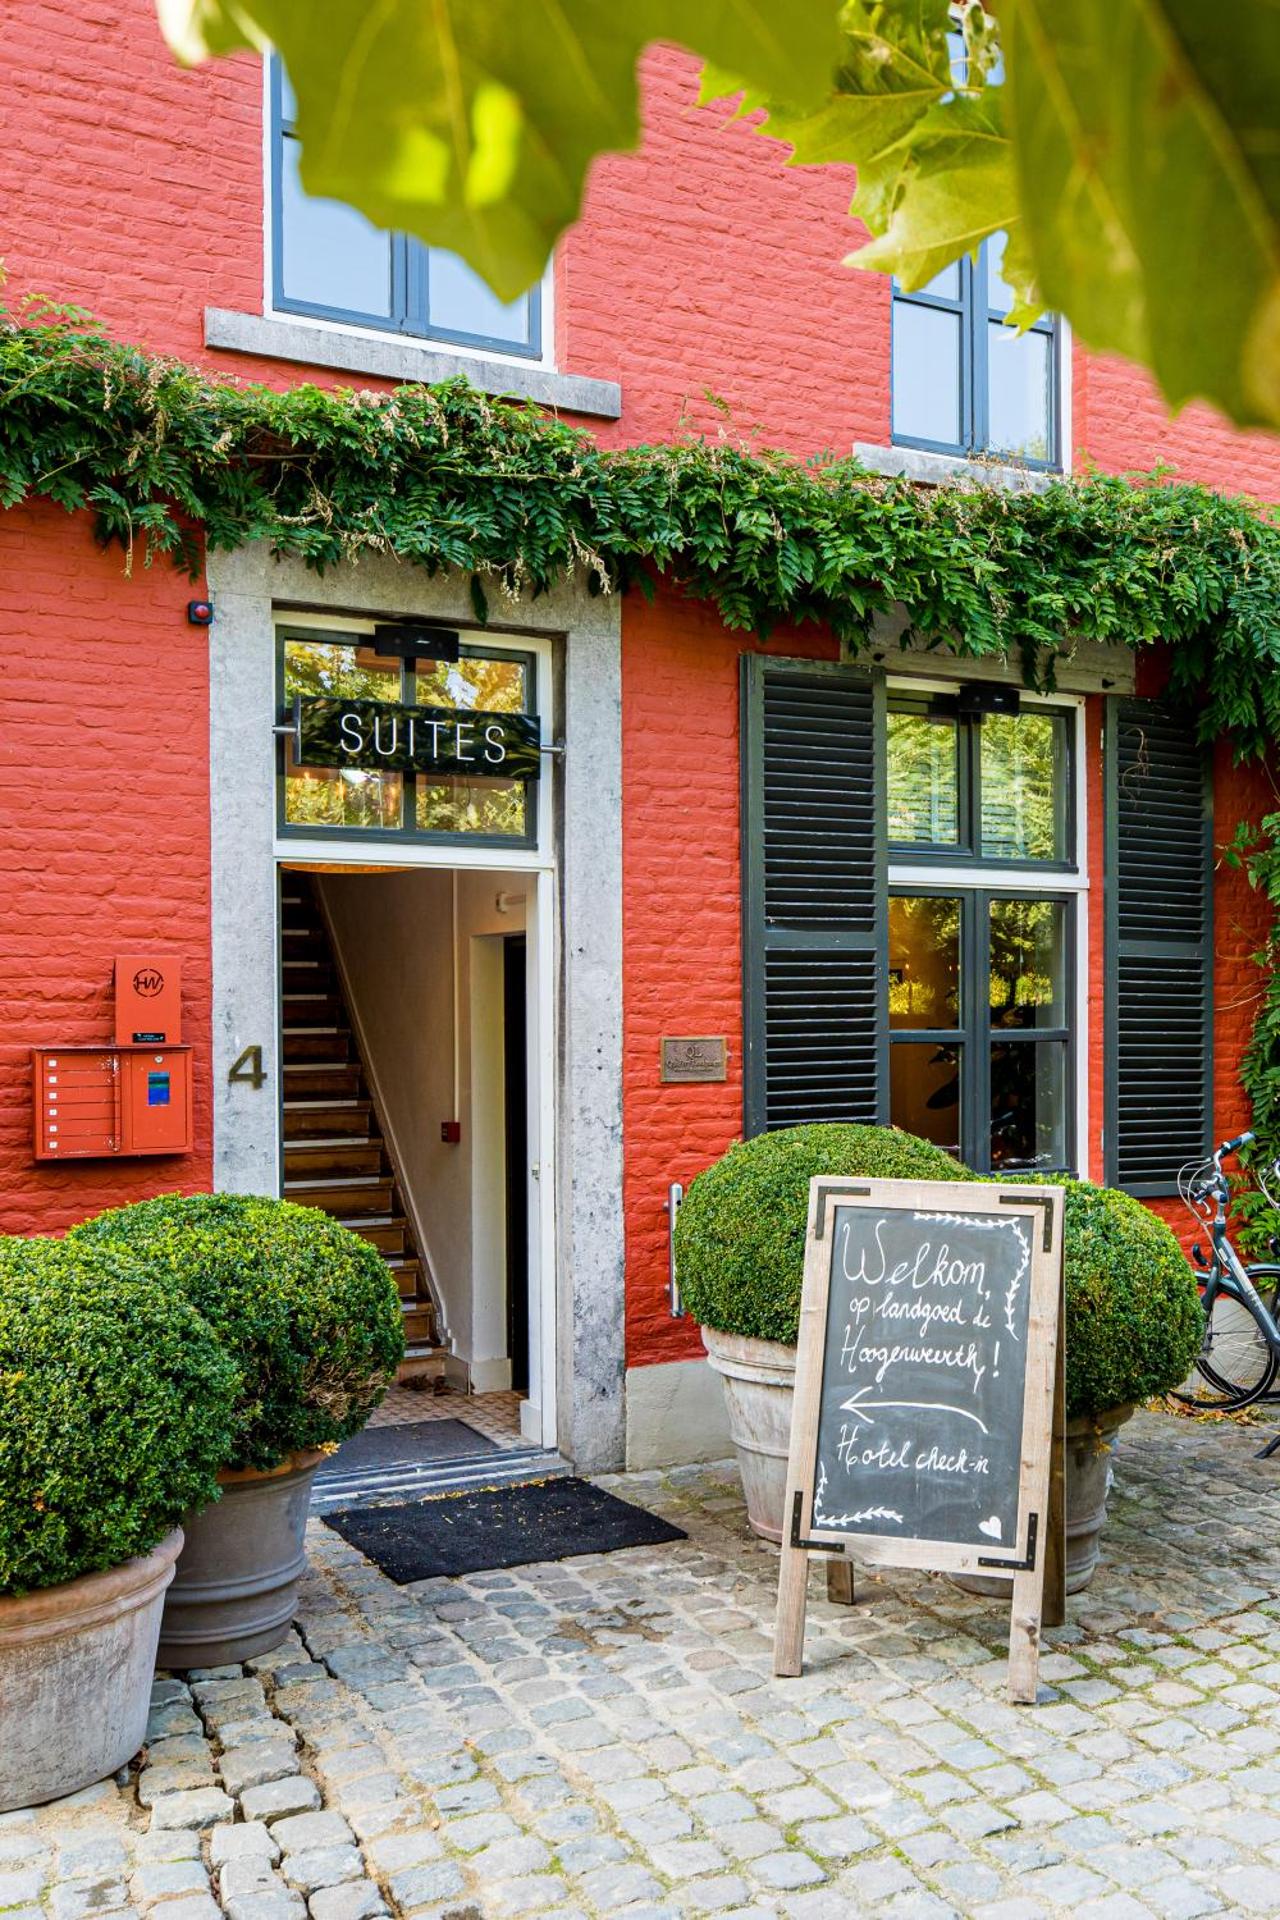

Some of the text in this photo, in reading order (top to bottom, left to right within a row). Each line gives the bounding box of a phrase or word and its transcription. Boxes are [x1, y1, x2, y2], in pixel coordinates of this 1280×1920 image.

[340, 713, 506, 763] SUITES
[228, 1045, 267, 1090] 4
[843, 1219, 991, 1300] Welkom,
[849, 1291, 992, 1338] op landgoed de
[837, 1424, 989, 1475] Hotel check-in
